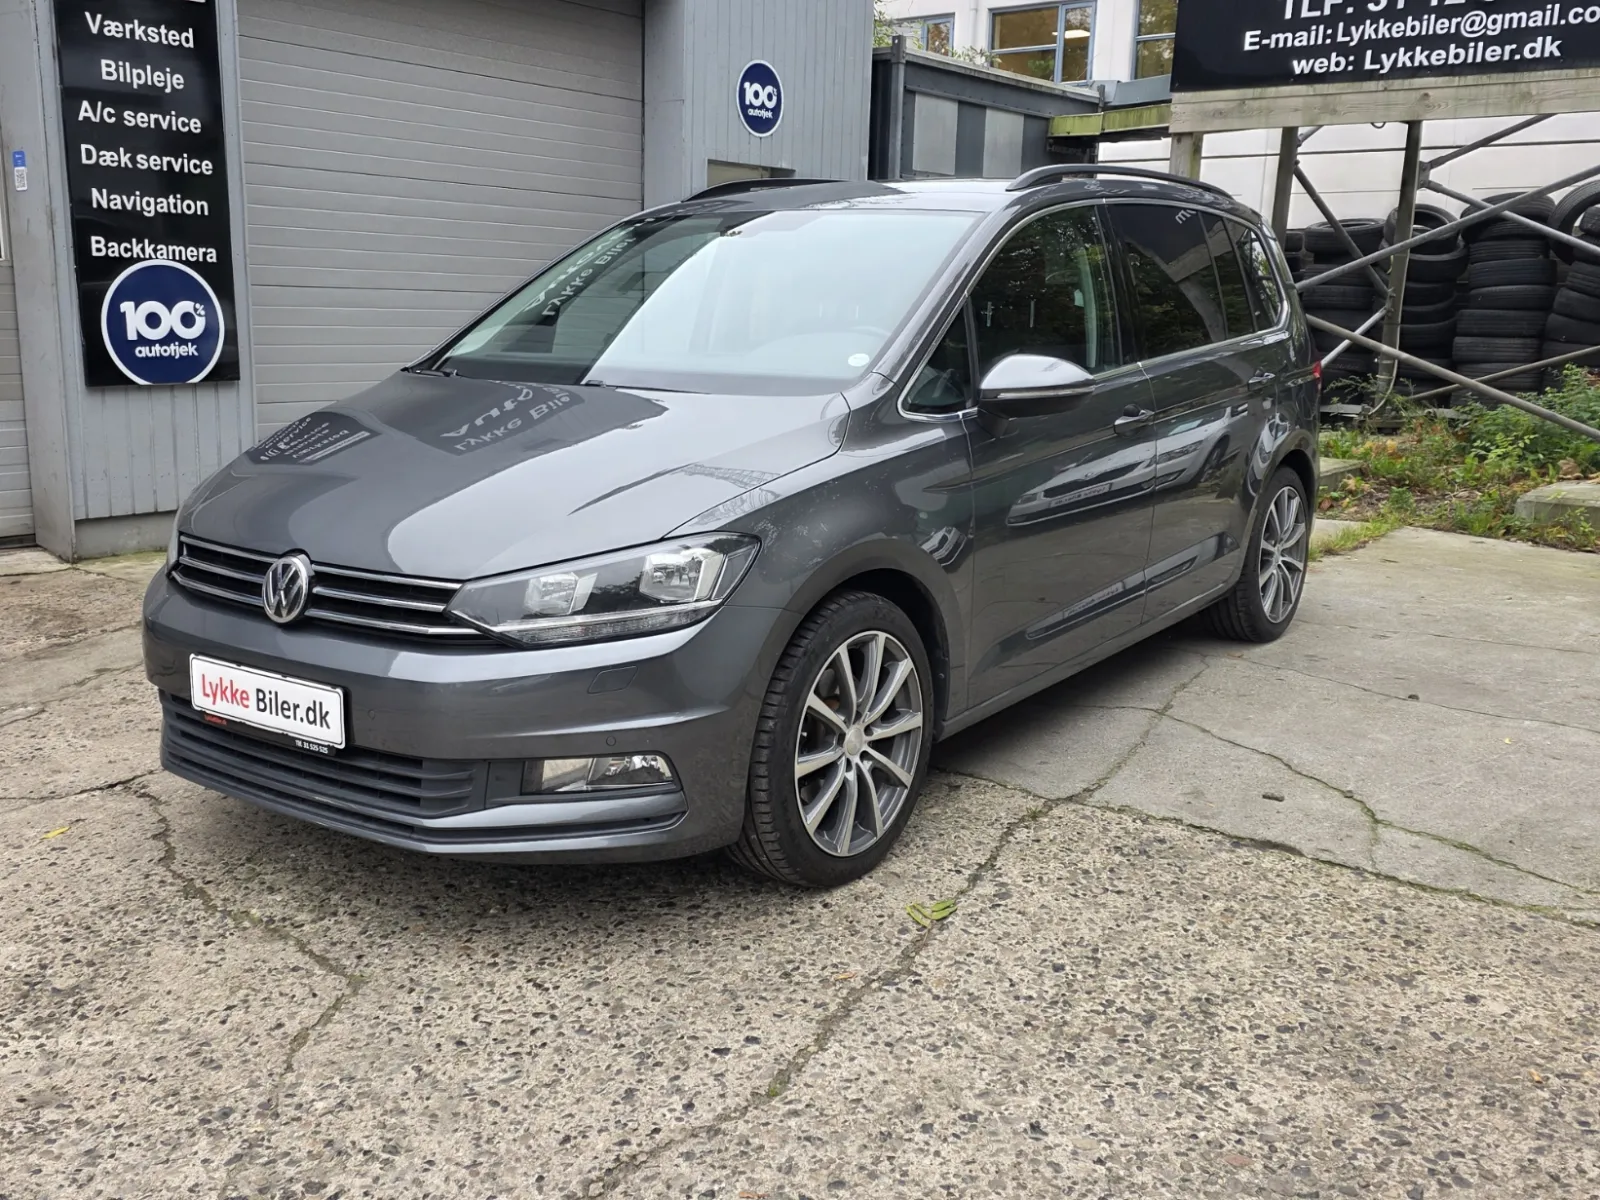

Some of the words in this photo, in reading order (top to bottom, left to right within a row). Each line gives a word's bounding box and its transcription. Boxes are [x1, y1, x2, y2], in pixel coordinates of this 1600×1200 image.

[85, 11, 194, 48] Værksted
[1243, 25, 1333, 52] E-mail:
[1292, 53, 1355, 75] web:
[1364, 35, 1562, 74] Lykkebiler.dk
[100, 58, 185, 93] Bilpleje
[77, 99, 117, 124] A/c
[123, 110, 202, 134] service
[747, 107, 774, 120] autotjek
[80, 143, 133, 169] Dæk
[136, 149, 213, 175] service
[91, 187, 209, 217] Navigation
[90, 235, 217, 263] Backkamera
[134, 341, 199, 359] autotjek
[201, 673, 250, 709] Lykke
[255, 687, 331, 730] Biler.dk
